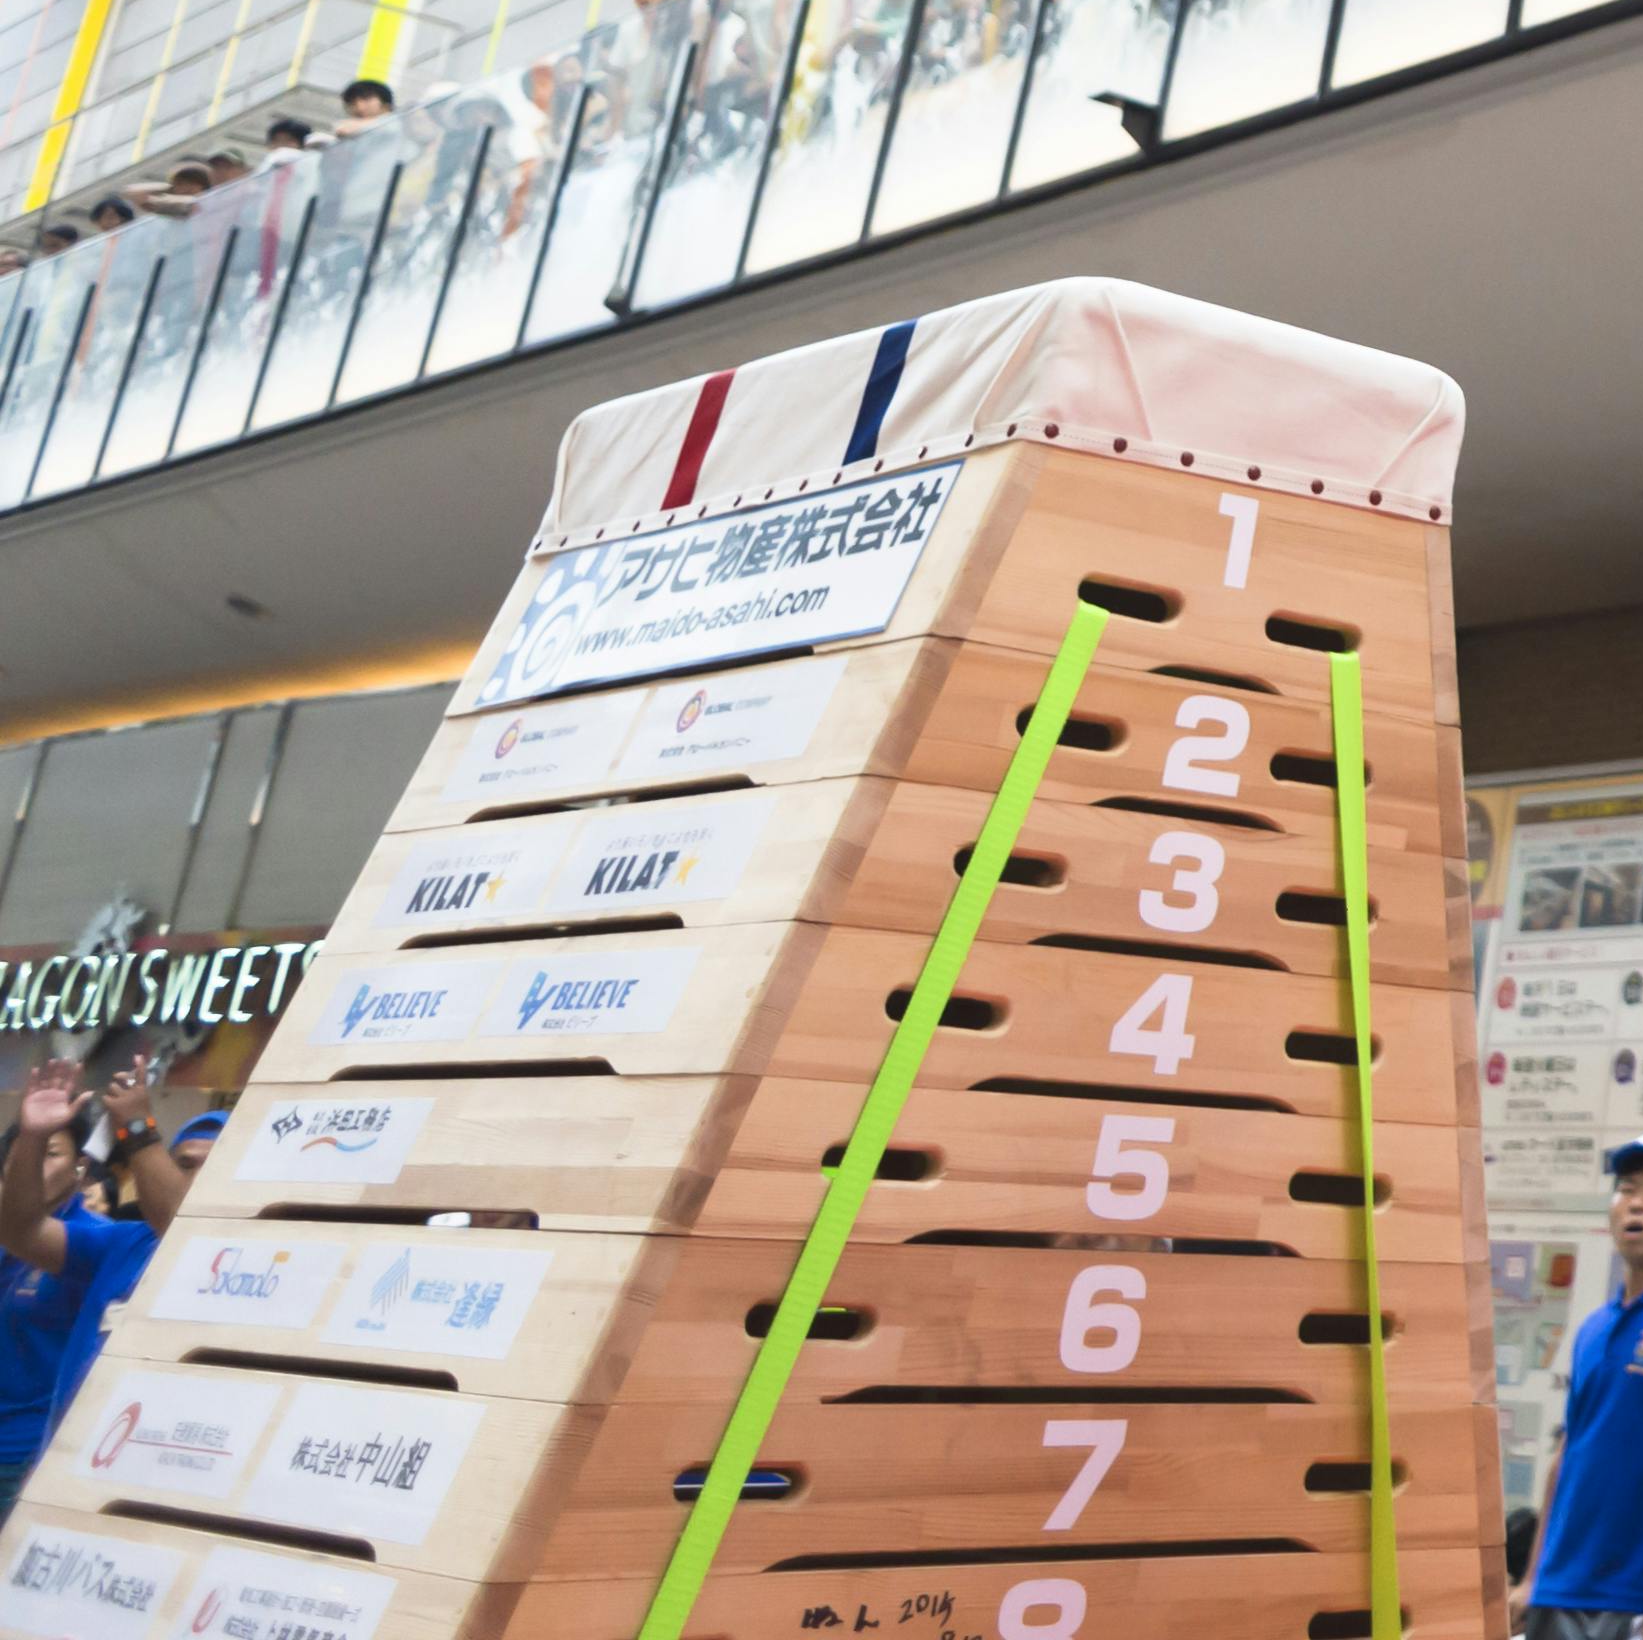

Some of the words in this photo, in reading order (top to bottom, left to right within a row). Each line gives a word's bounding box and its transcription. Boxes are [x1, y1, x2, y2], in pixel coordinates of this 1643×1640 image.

[617, 476, 943, 602] アサヒ物産株式会社
[1218, 492, 1259, 589] 1
[575, 585, 831, 657] www.maido-asahi.com
[1161, 695, 1251, 799] 2
[405, 871, 491, 914] KILAT
[584, 850, 680, 896] KILAT
[1137, 833, 1221, 933] 3
[0, 952, 138, 1030] AGON
[372, 989, 449, 1021] BELIEVE
[551, 978, 640, 1011] BELIEVE
[1109, 973, 1196, 1075] 4
[1085, 1114, 1177, 1221] 5
[1059, 1265, 1148, 1373] 6
[1040, 1419, 1128, 1531] 7
